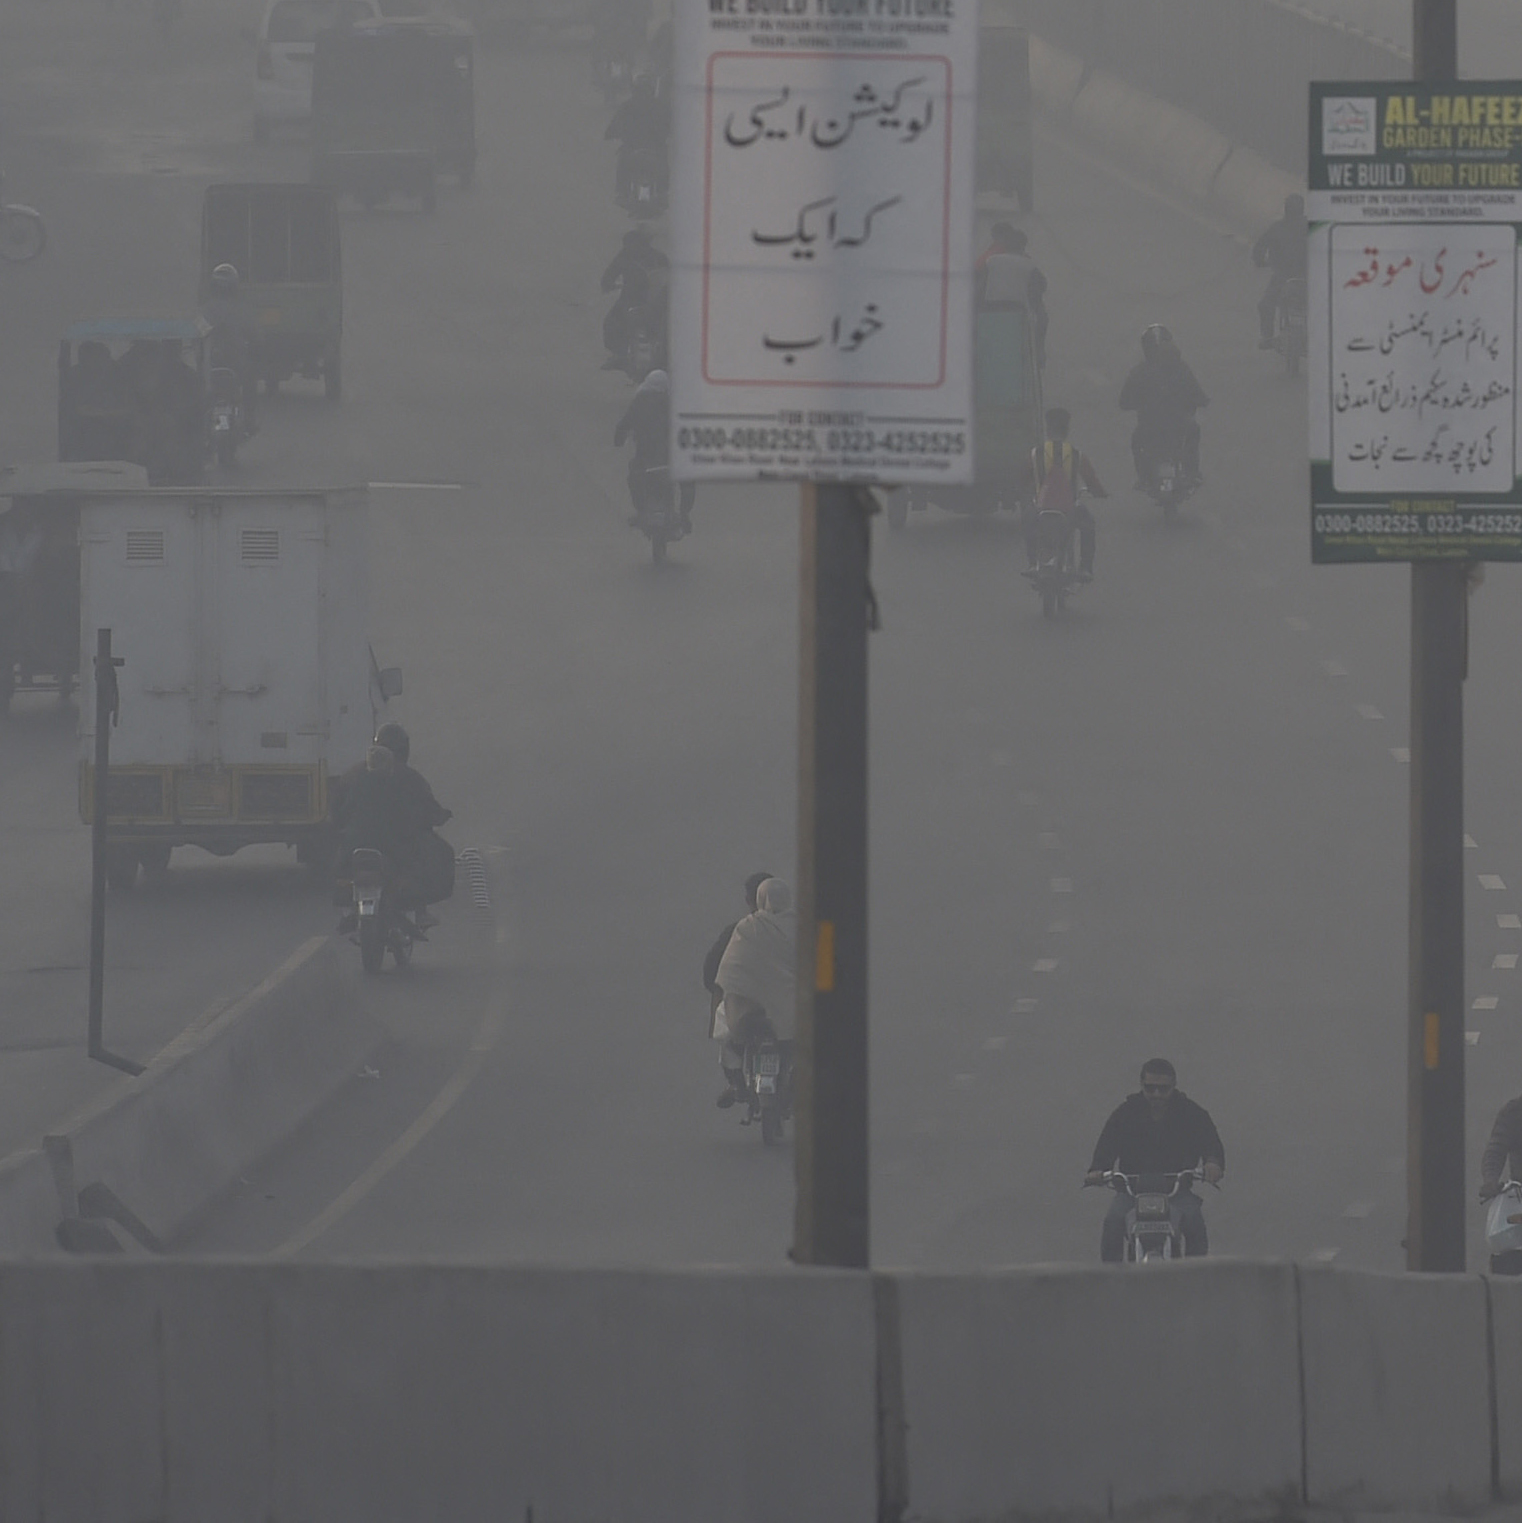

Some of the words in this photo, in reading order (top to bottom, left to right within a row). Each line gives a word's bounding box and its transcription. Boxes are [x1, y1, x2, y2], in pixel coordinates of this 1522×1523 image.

[723, 86, 805, 148] ایسی
[810, 76, 934, 148] لوکیشن
[1383, 127, 1451, 148] GARDEN
[1327, 163, 1353, 186] WE
[1358, 163, 1406, 186] BUILD
[1411, 163, 1453, 186] YOUR
[1459, 163, 1521, 186] FUTURE
[750, 195, 838, 261] ایک
[833, 194, 904, 249] کہ
[1344, 246, 1412, 289] موقعہ
[1419, 247, 1497, 299] سنہری
[762, 302, 884, 365] خواب
[1347, 337, 1375, 351] سے
[1335, 373, 1376, 412] آمدنی
[1349, 435, 1388, 470] نجات
[1392, 447, 1417, 461] سے
